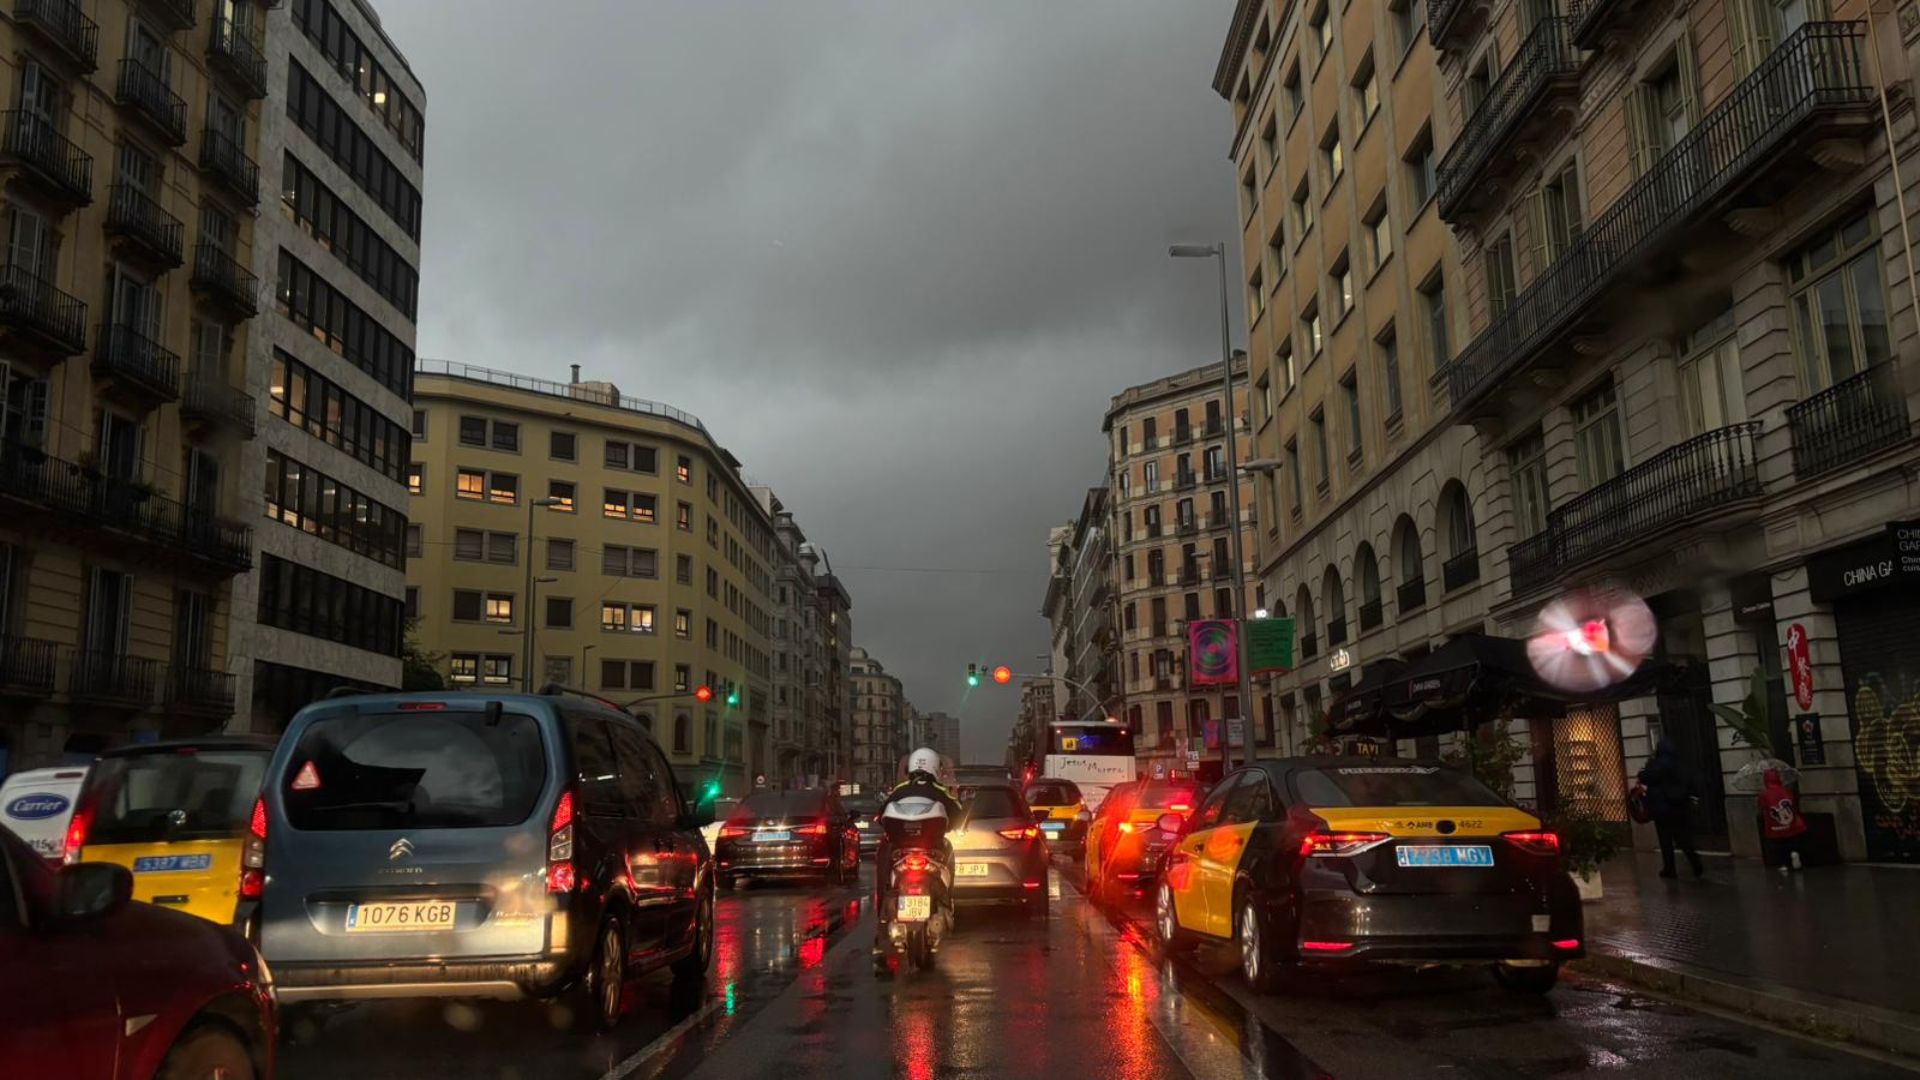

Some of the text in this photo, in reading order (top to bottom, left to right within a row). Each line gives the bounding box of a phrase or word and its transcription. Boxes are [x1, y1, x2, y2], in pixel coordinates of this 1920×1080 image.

[1897, 529, 1920, 540] CHI
[1844, 565, 1877, 587] CHINA
[13, 799, 62, 812] Carrier
[363, 904, 452, 926] 1076 KGB
